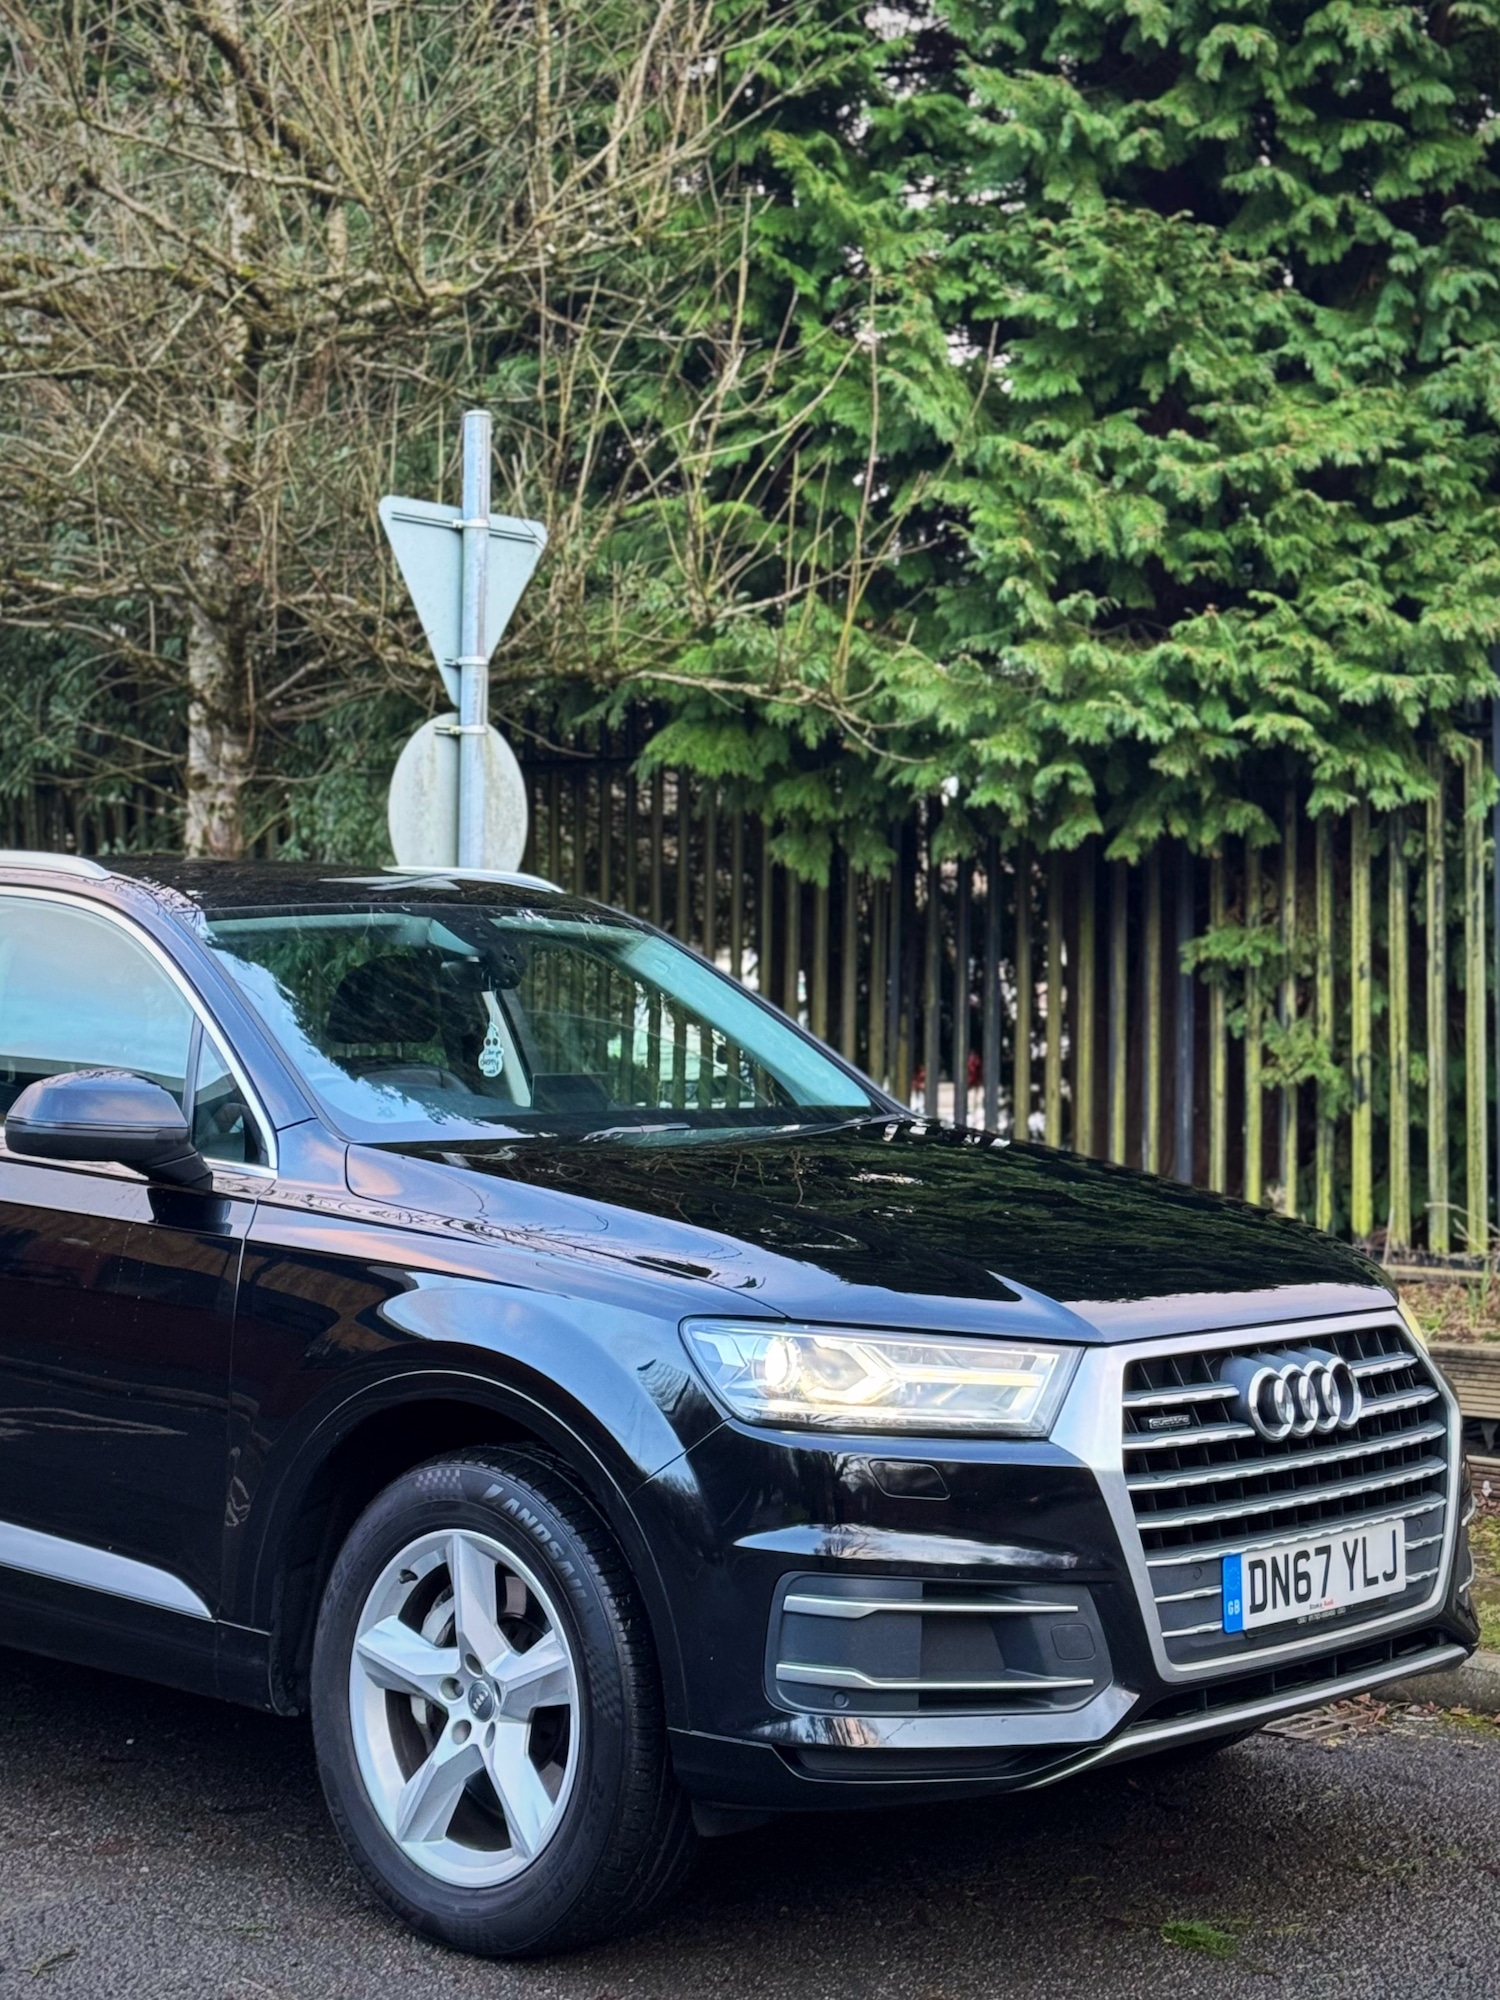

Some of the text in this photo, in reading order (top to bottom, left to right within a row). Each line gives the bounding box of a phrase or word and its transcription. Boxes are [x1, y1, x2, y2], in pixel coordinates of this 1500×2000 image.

[482, 1483, 589, 1600] LANDSAIL
[1248, 1529, 1397, 1614] DN67 YLJ
[1227, 1599, 1240, 1616] GB
